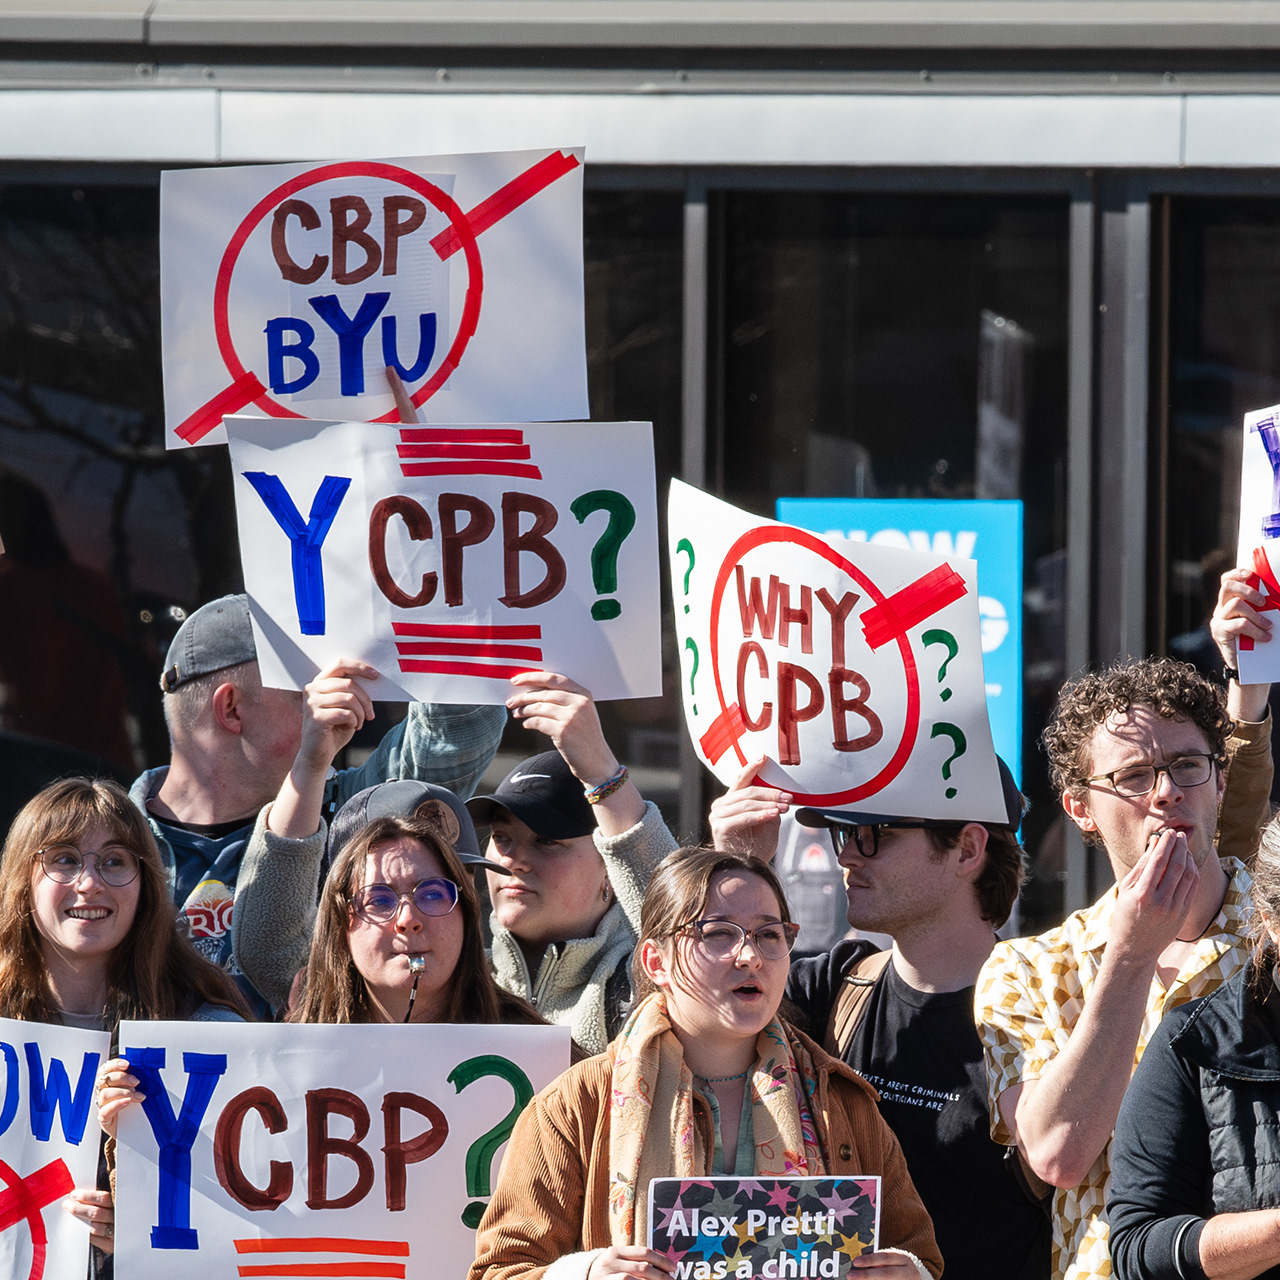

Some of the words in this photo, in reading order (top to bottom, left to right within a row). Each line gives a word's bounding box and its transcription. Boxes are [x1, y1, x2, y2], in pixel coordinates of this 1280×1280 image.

[271, 194, 428, 285] CBP
[263, 291, 436, 397] BYU
[241, 471, 352, 636] Y
[369, 489, 637, 621] CPB?
[735, 564, 861, 668] WHY
[737, 640, 884, 766] CPB
[911, 1085, 960, 1102] CRIMINALS
[926, 1102, 943, 1112] ARE
[119, 1047, 228, 1250] Y
[213, 1054, 535, 1230] CBP?
[666, 1209, 738, 1237] Alex
[747, 1208, 836, 1237] Pretti
[670, 1259, 729, 1280] was
[735, 1259, 754, 1280] a
[761, 1250, 840, 1279] child
